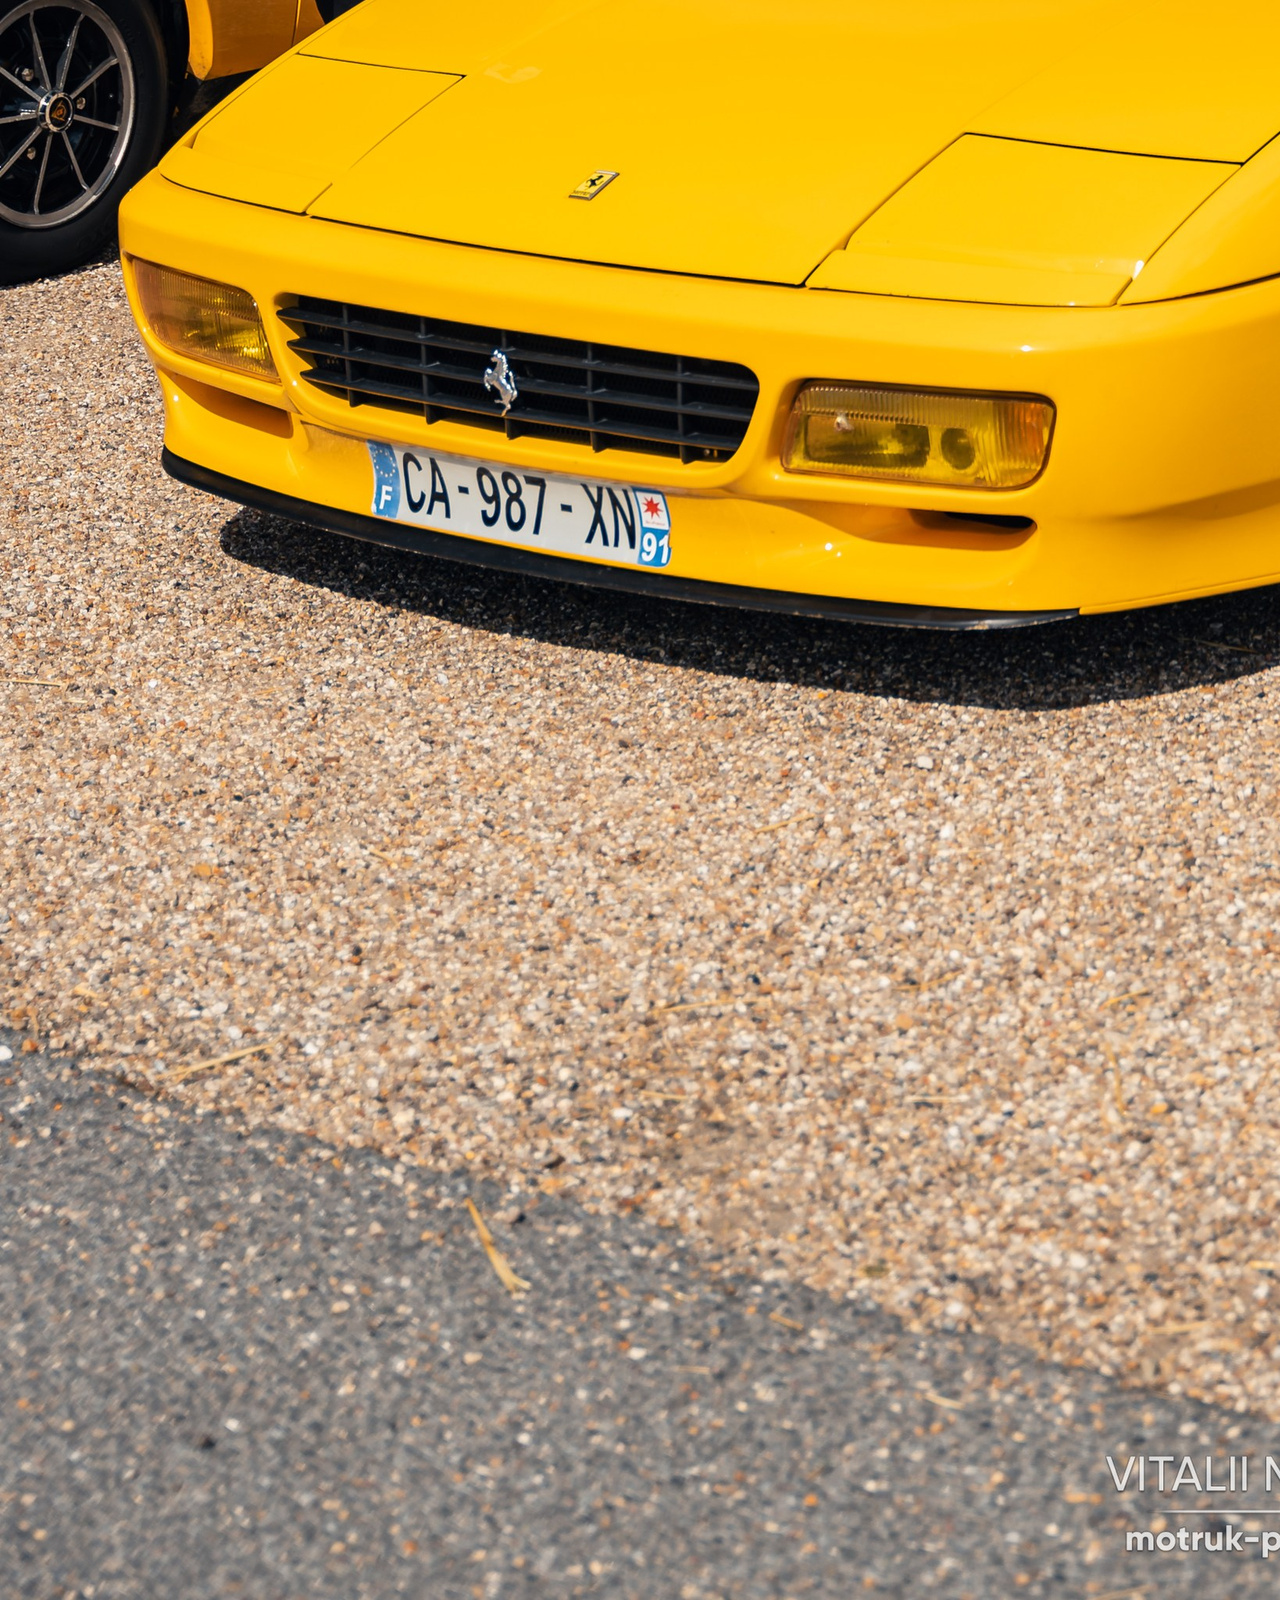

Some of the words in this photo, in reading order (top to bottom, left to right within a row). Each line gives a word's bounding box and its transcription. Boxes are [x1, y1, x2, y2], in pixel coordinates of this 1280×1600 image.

[378, 484, 393, 510] F
[402, 451, 637, 550] CA-987-XN
[641, 532, 669, 564] 91
